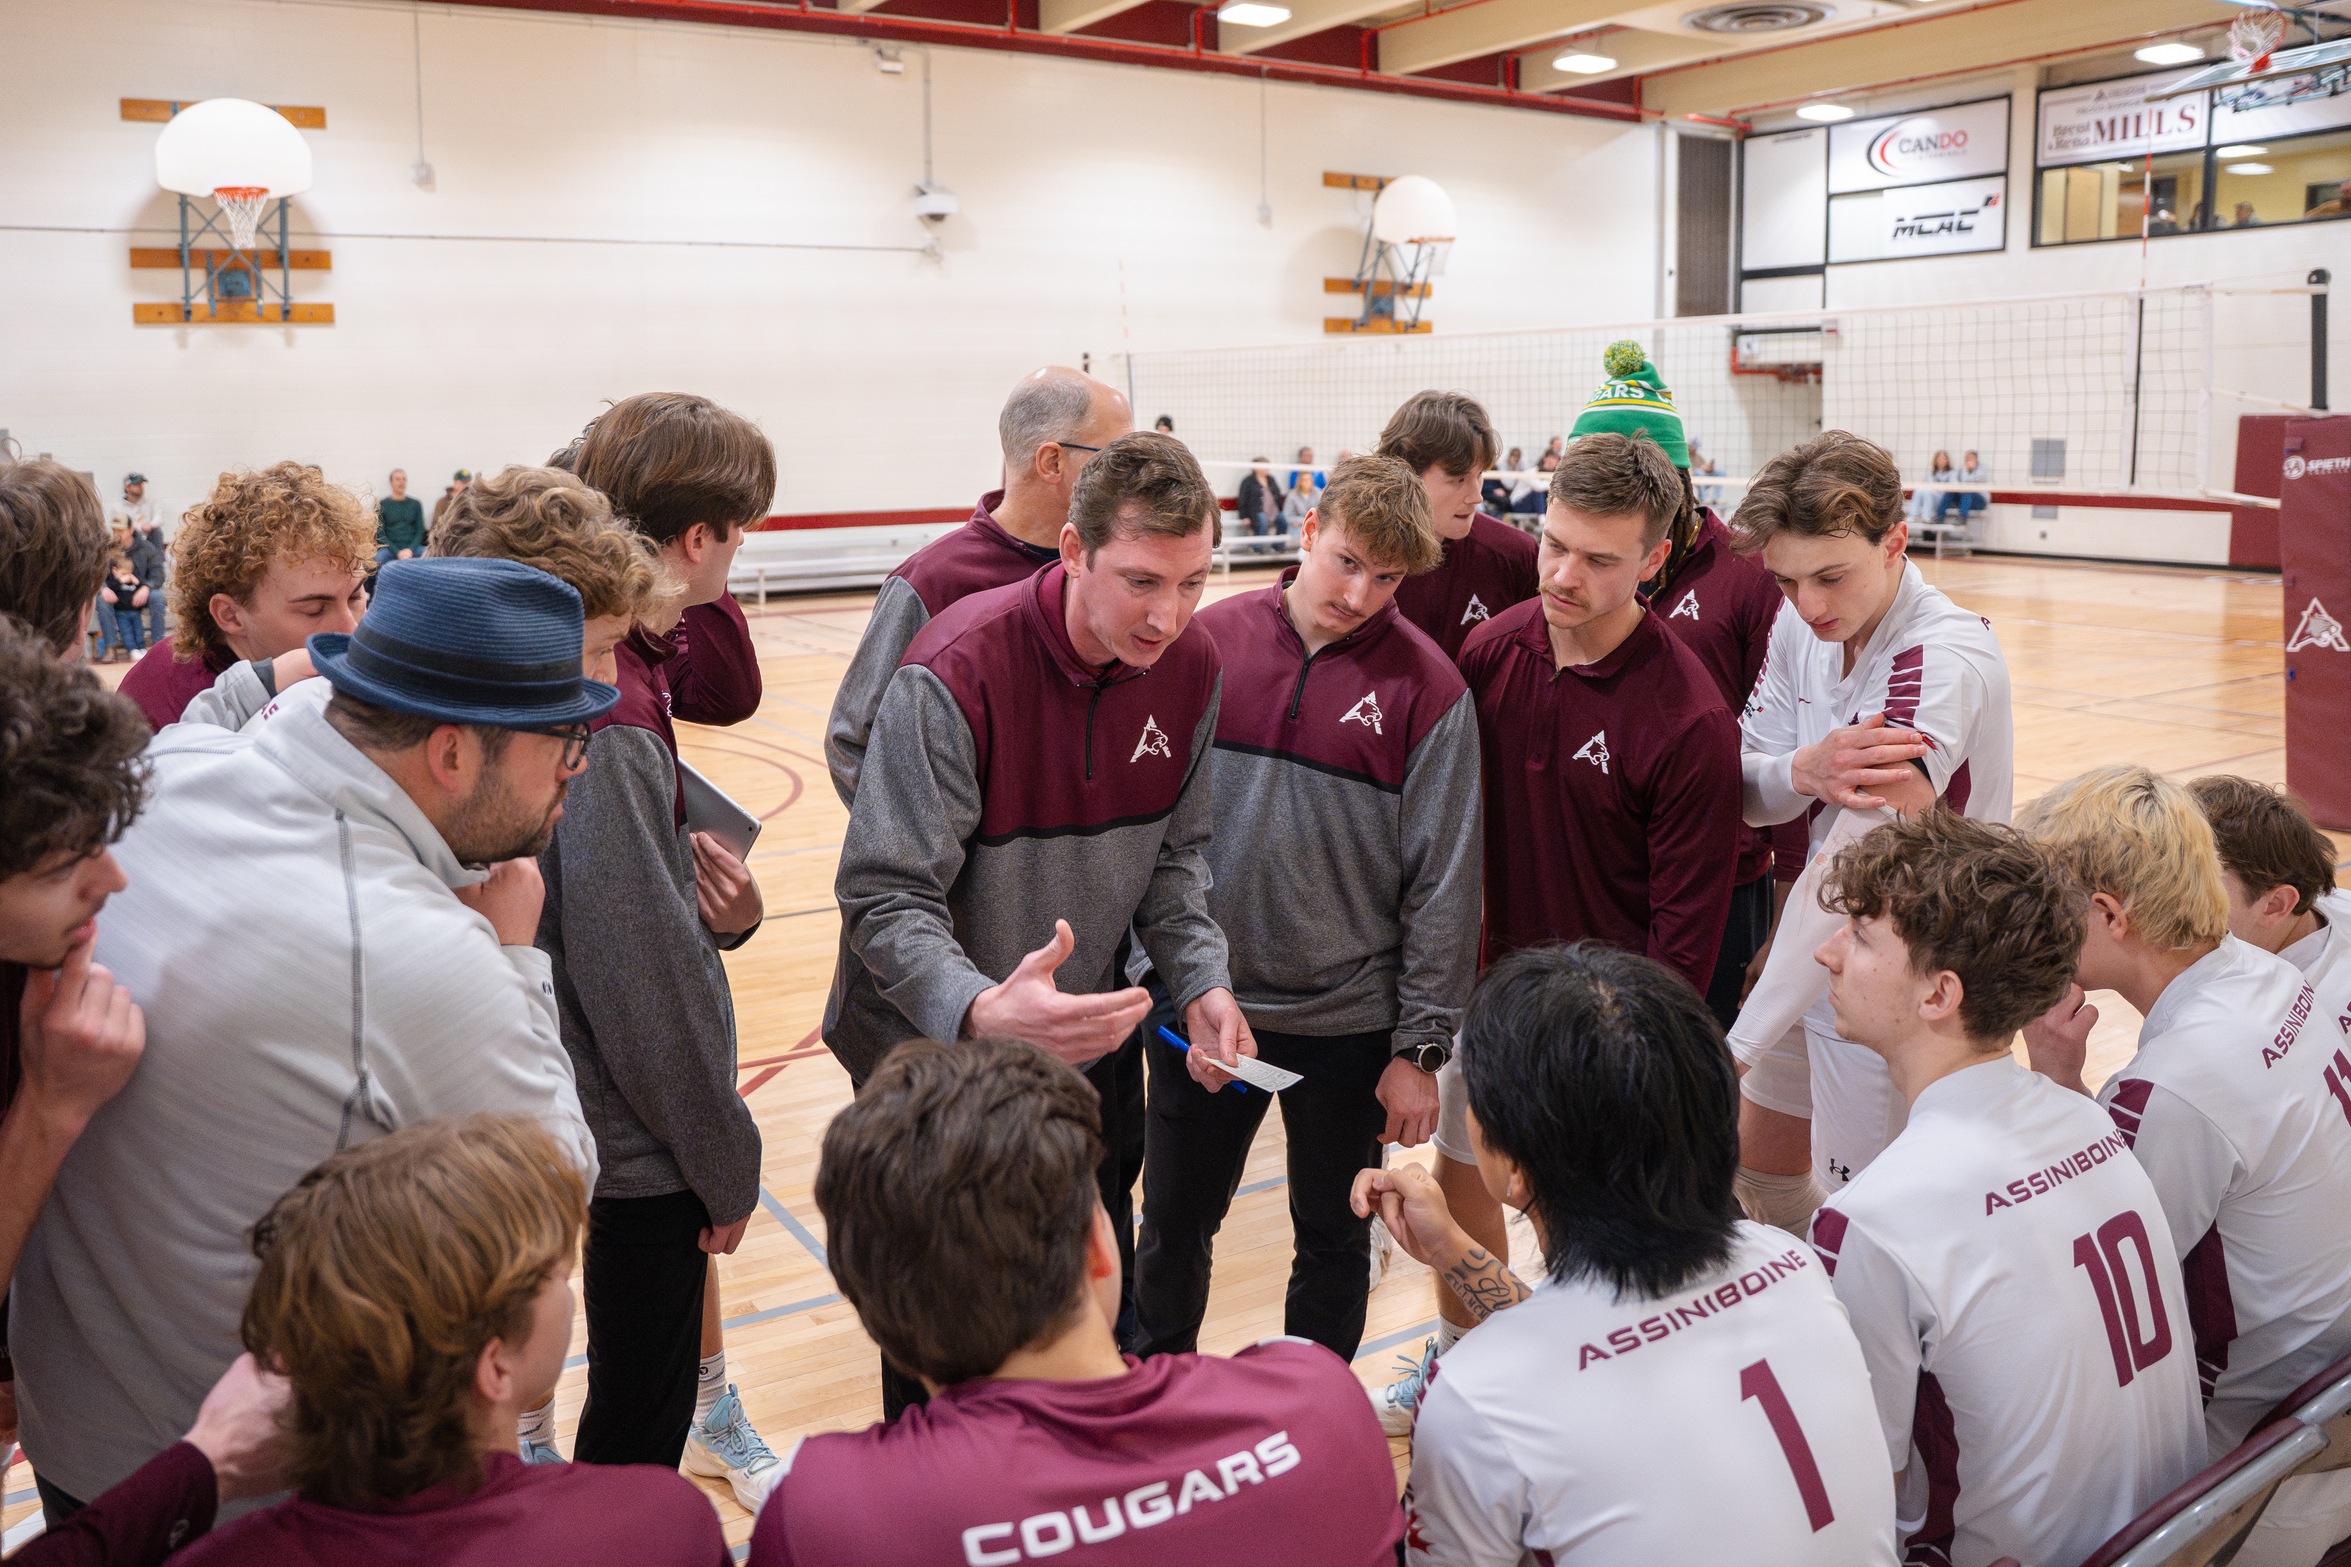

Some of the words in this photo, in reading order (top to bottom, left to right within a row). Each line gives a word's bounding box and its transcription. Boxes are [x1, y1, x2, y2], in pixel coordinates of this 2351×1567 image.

[1898, 129, 1968, 154] CANDO
[2093, 103, 2197, 145] MILLS
[1588, 384, 1645, 403] GARS
[2261, 979, 2316, 1069] ASSINIBOIN
[1578, 1249, 1808, 1372] ASSINIBOINE
[2073, 1209, 2173, 1388] 10
[960, 1430, 1301, 1567] COUGARS
[1739, 1357, 1836, 1534] 1
